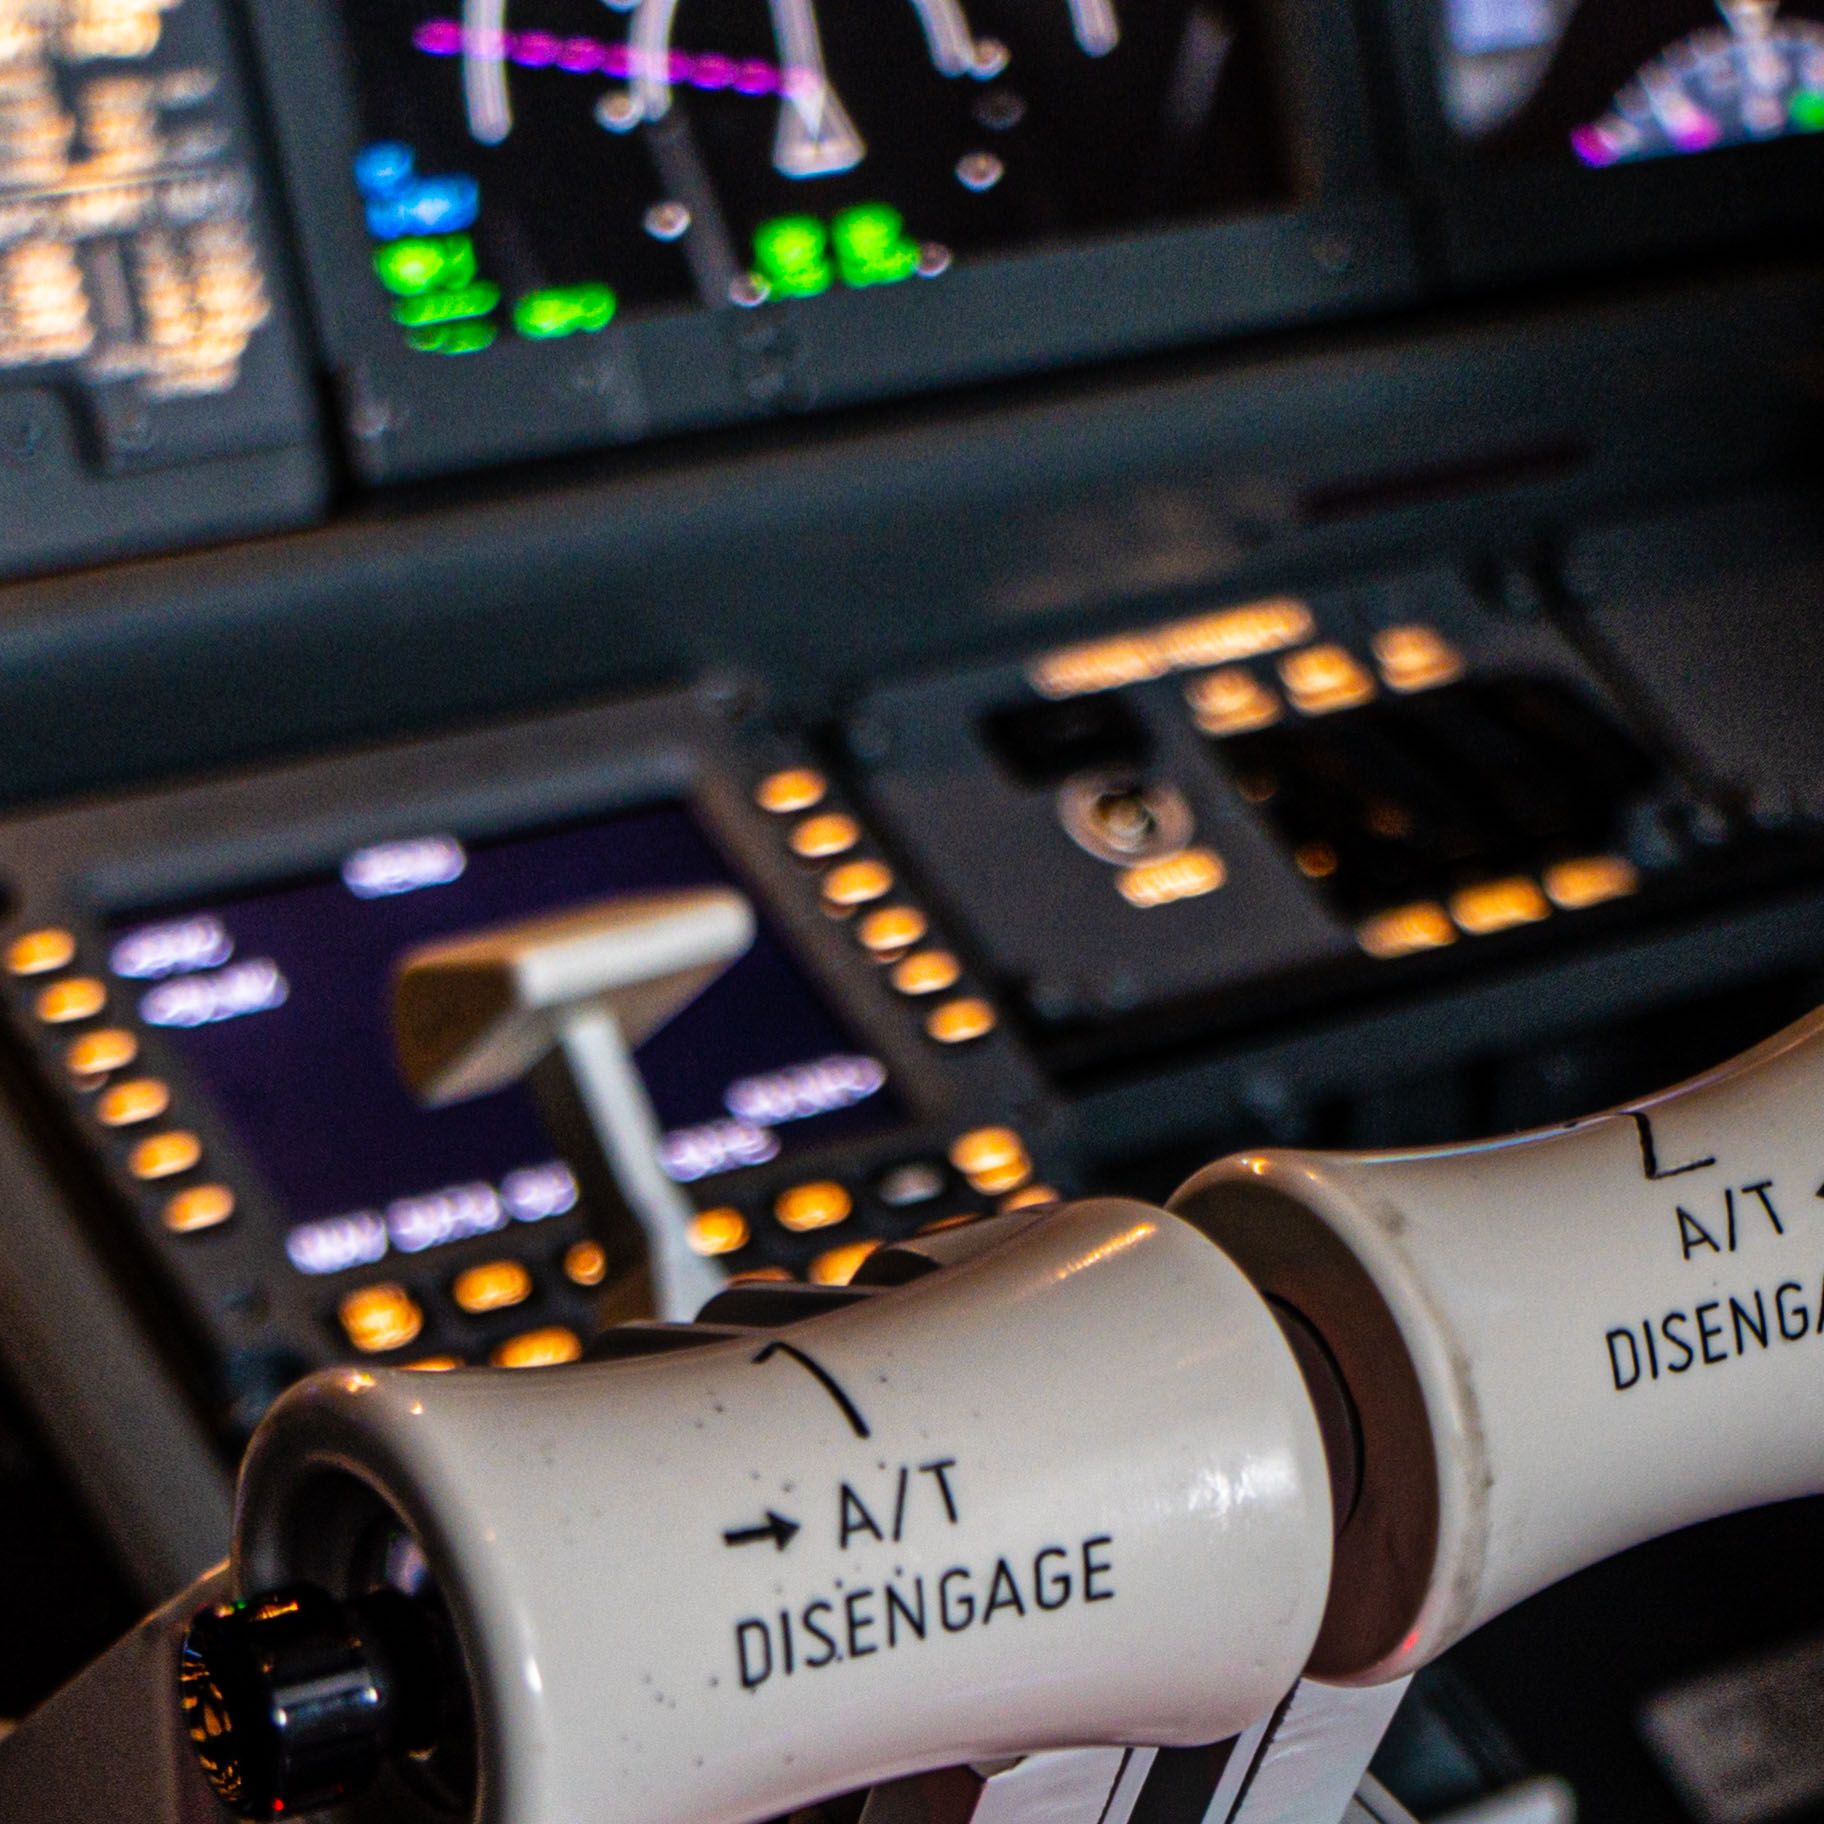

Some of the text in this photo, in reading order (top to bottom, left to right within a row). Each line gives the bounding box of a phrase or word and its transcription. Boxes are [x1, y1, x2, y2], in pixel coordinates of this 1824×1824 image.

[1675, 1180, 1785, 1261] A/T
[838, 1458, 959, 1550] A/T
[735, 1535, 1115, 1690] DISENGAGE
